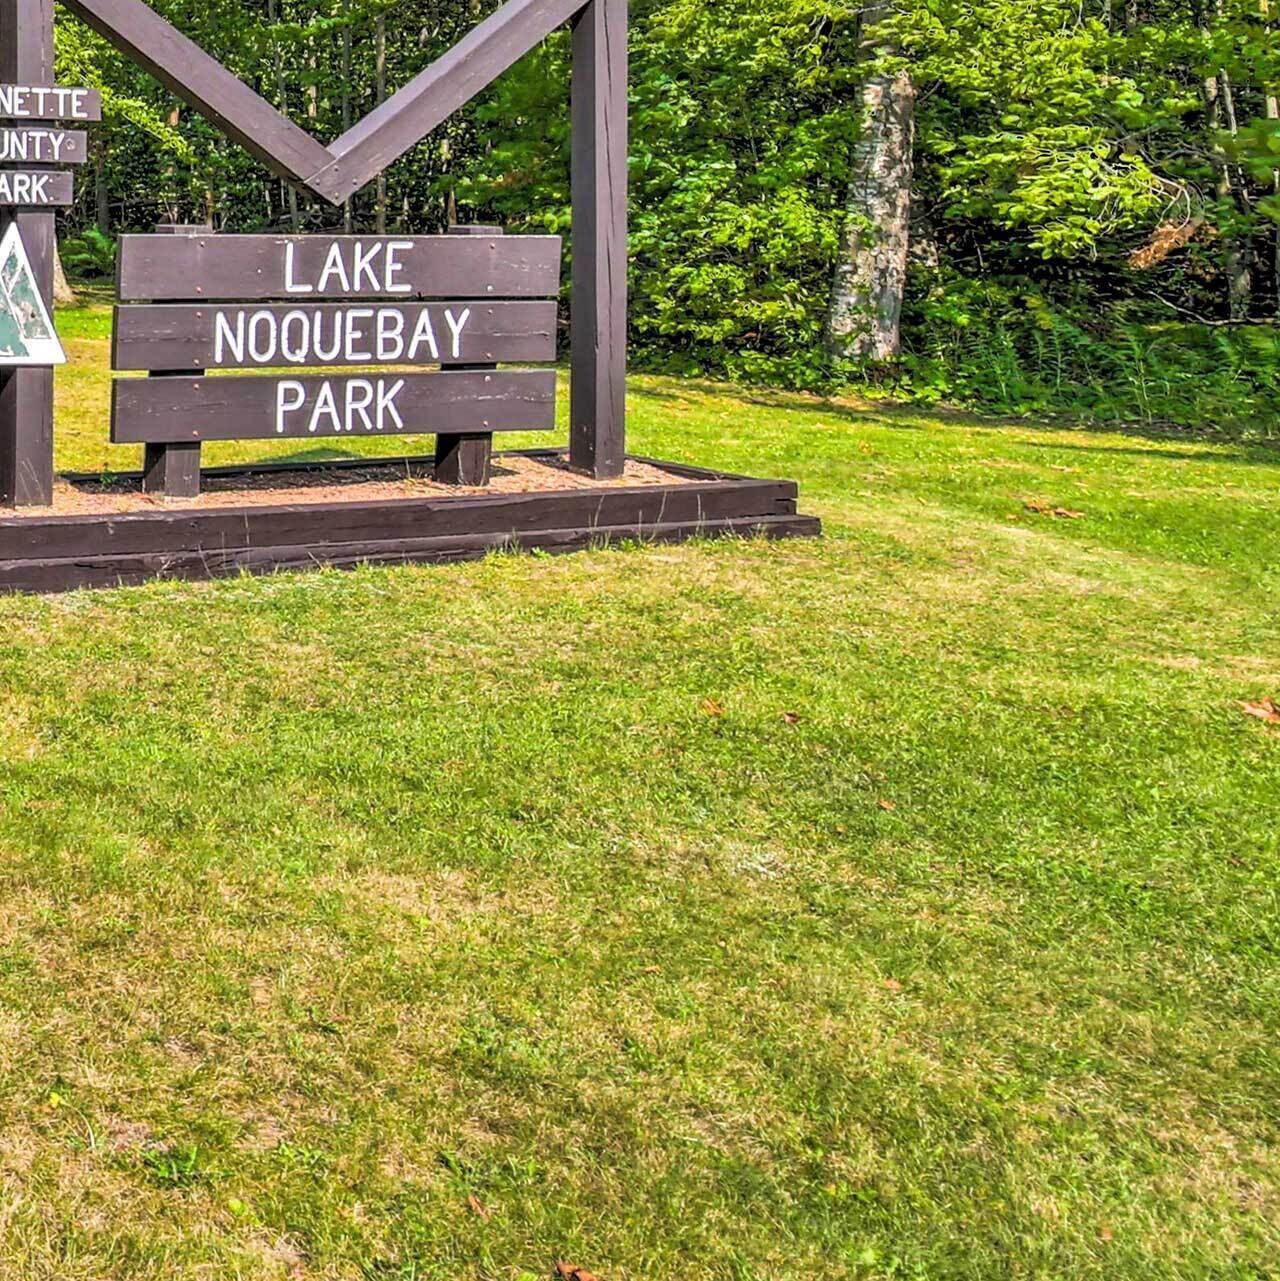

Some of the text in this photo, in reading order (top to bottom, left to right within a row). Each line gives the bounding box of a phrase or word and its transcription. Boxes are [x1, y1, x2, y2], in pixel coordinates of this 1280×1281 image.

[284, 241, 414, 293] LAKE
[214, 307, 471, 364] NOQUEBAY
[276, 378, 405, 433] PARK
